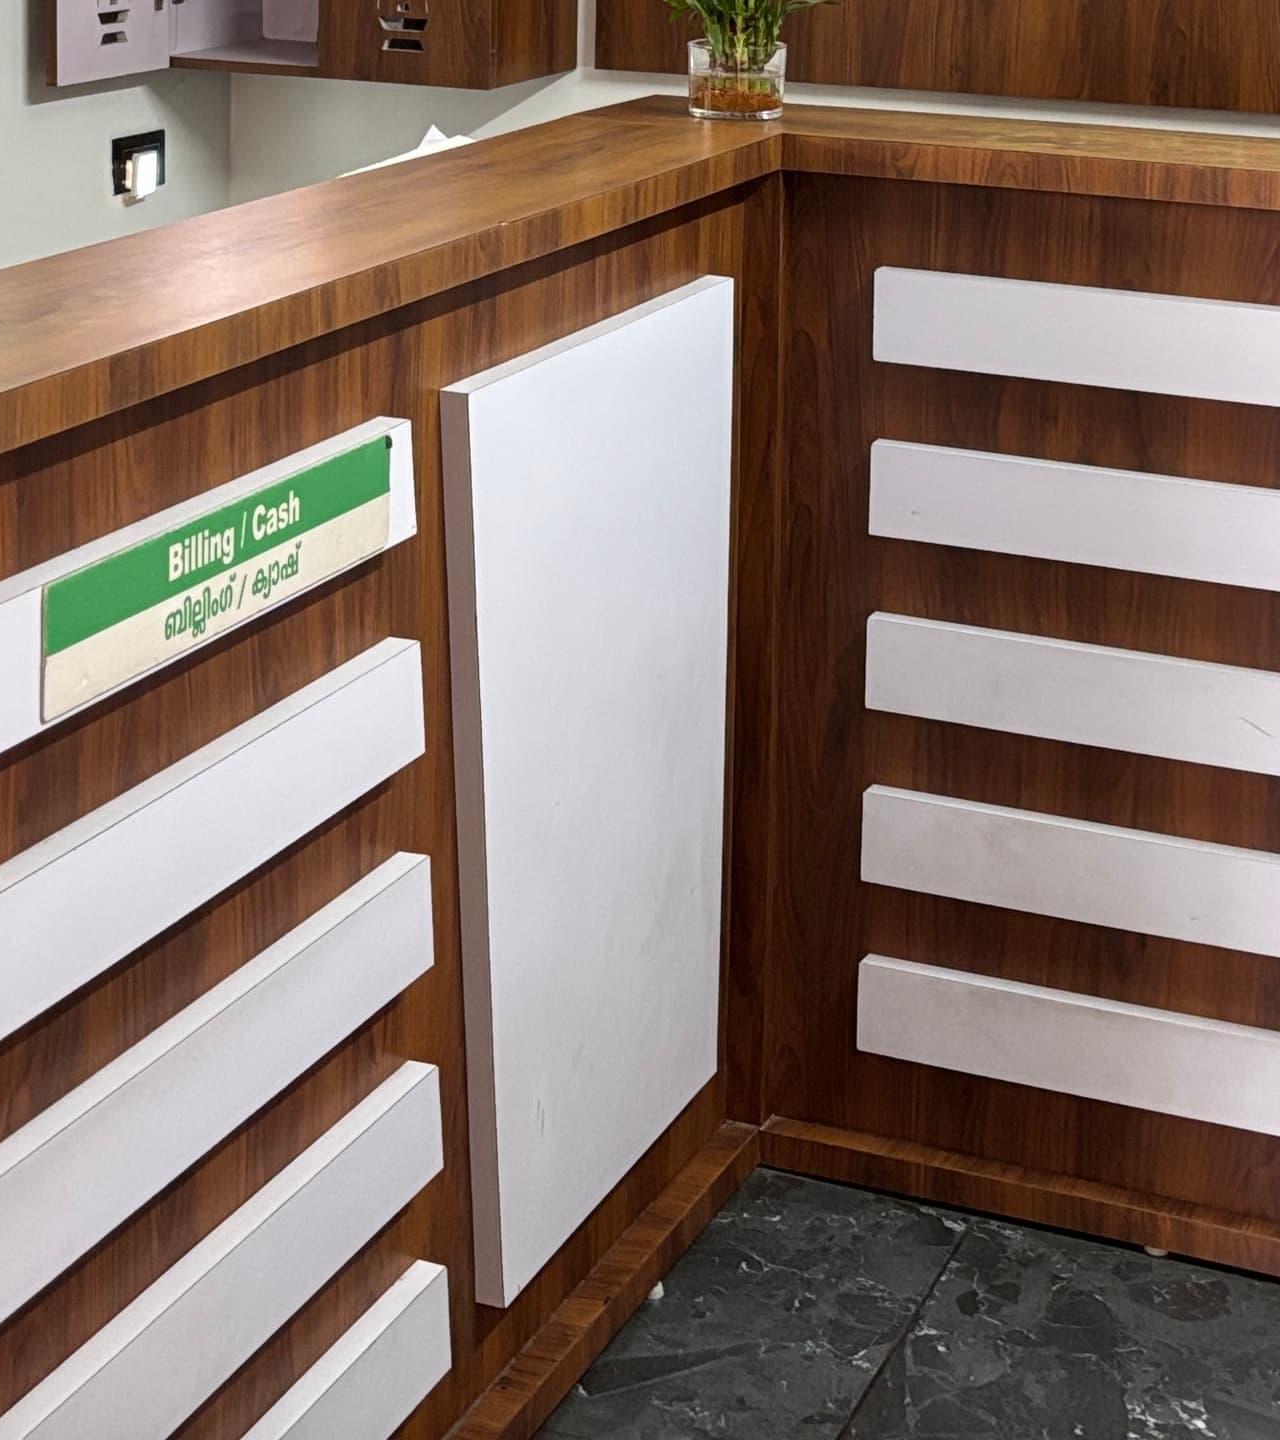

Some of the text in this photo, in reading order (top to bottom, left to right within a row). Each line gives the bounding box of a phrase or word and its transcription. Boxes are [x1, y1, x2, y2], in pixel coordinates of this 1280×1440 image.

[168, 490, 301, 582] Billing / Cash
[164, 540, 303, 641] ബില്ലിംഗ് / ക്യാഷ്
